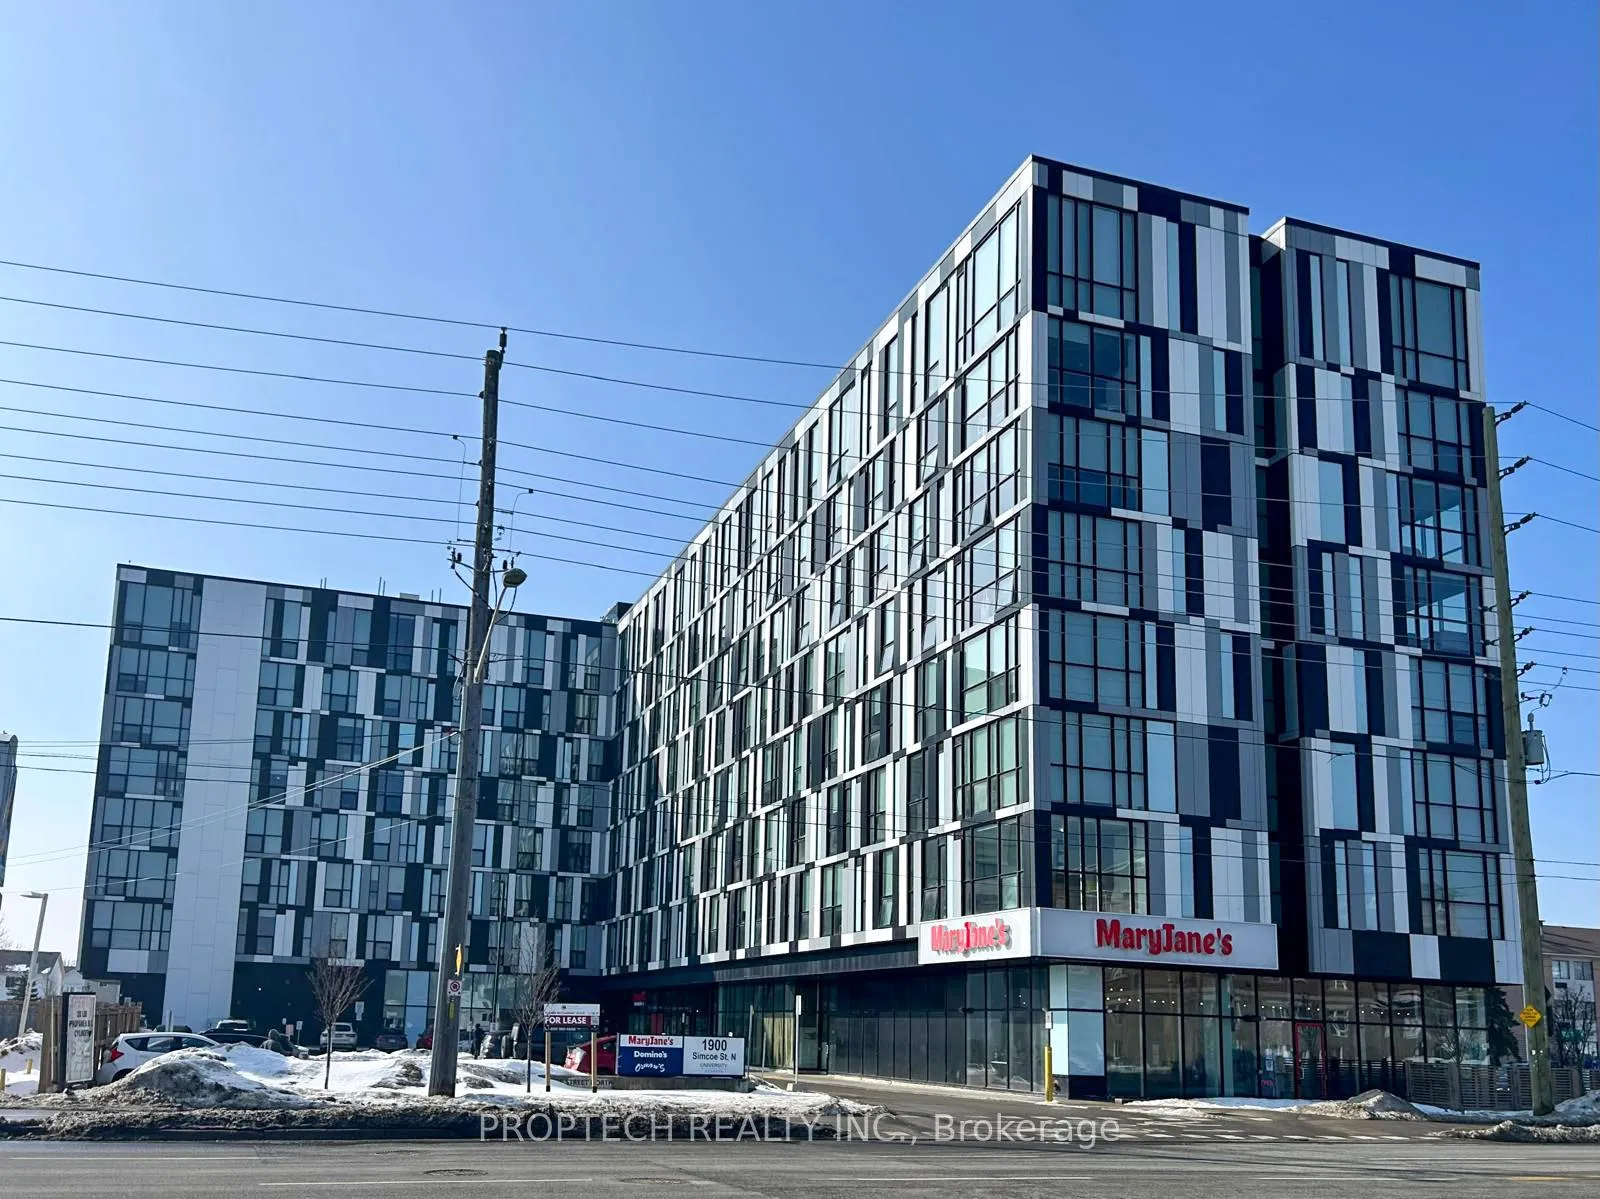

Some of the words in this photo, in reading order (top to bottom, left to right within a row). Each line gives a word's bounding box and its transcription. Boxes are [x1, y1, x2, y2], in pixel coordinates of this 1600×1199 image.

[1096, 918, 1233, 956] MaryJane's
[544, 1016, 562, 1025] FOR
[562, 1016, 587, 1025] LEASE
[628, 1036, 674, 1047] MaryJane's
[702, 1038, 727, 1051] 1900
[633, 1050, 668, 1059] Domino's
[692, 1051, 719, 1061] Simcoe
[730, 1053, 737, 1061] N
